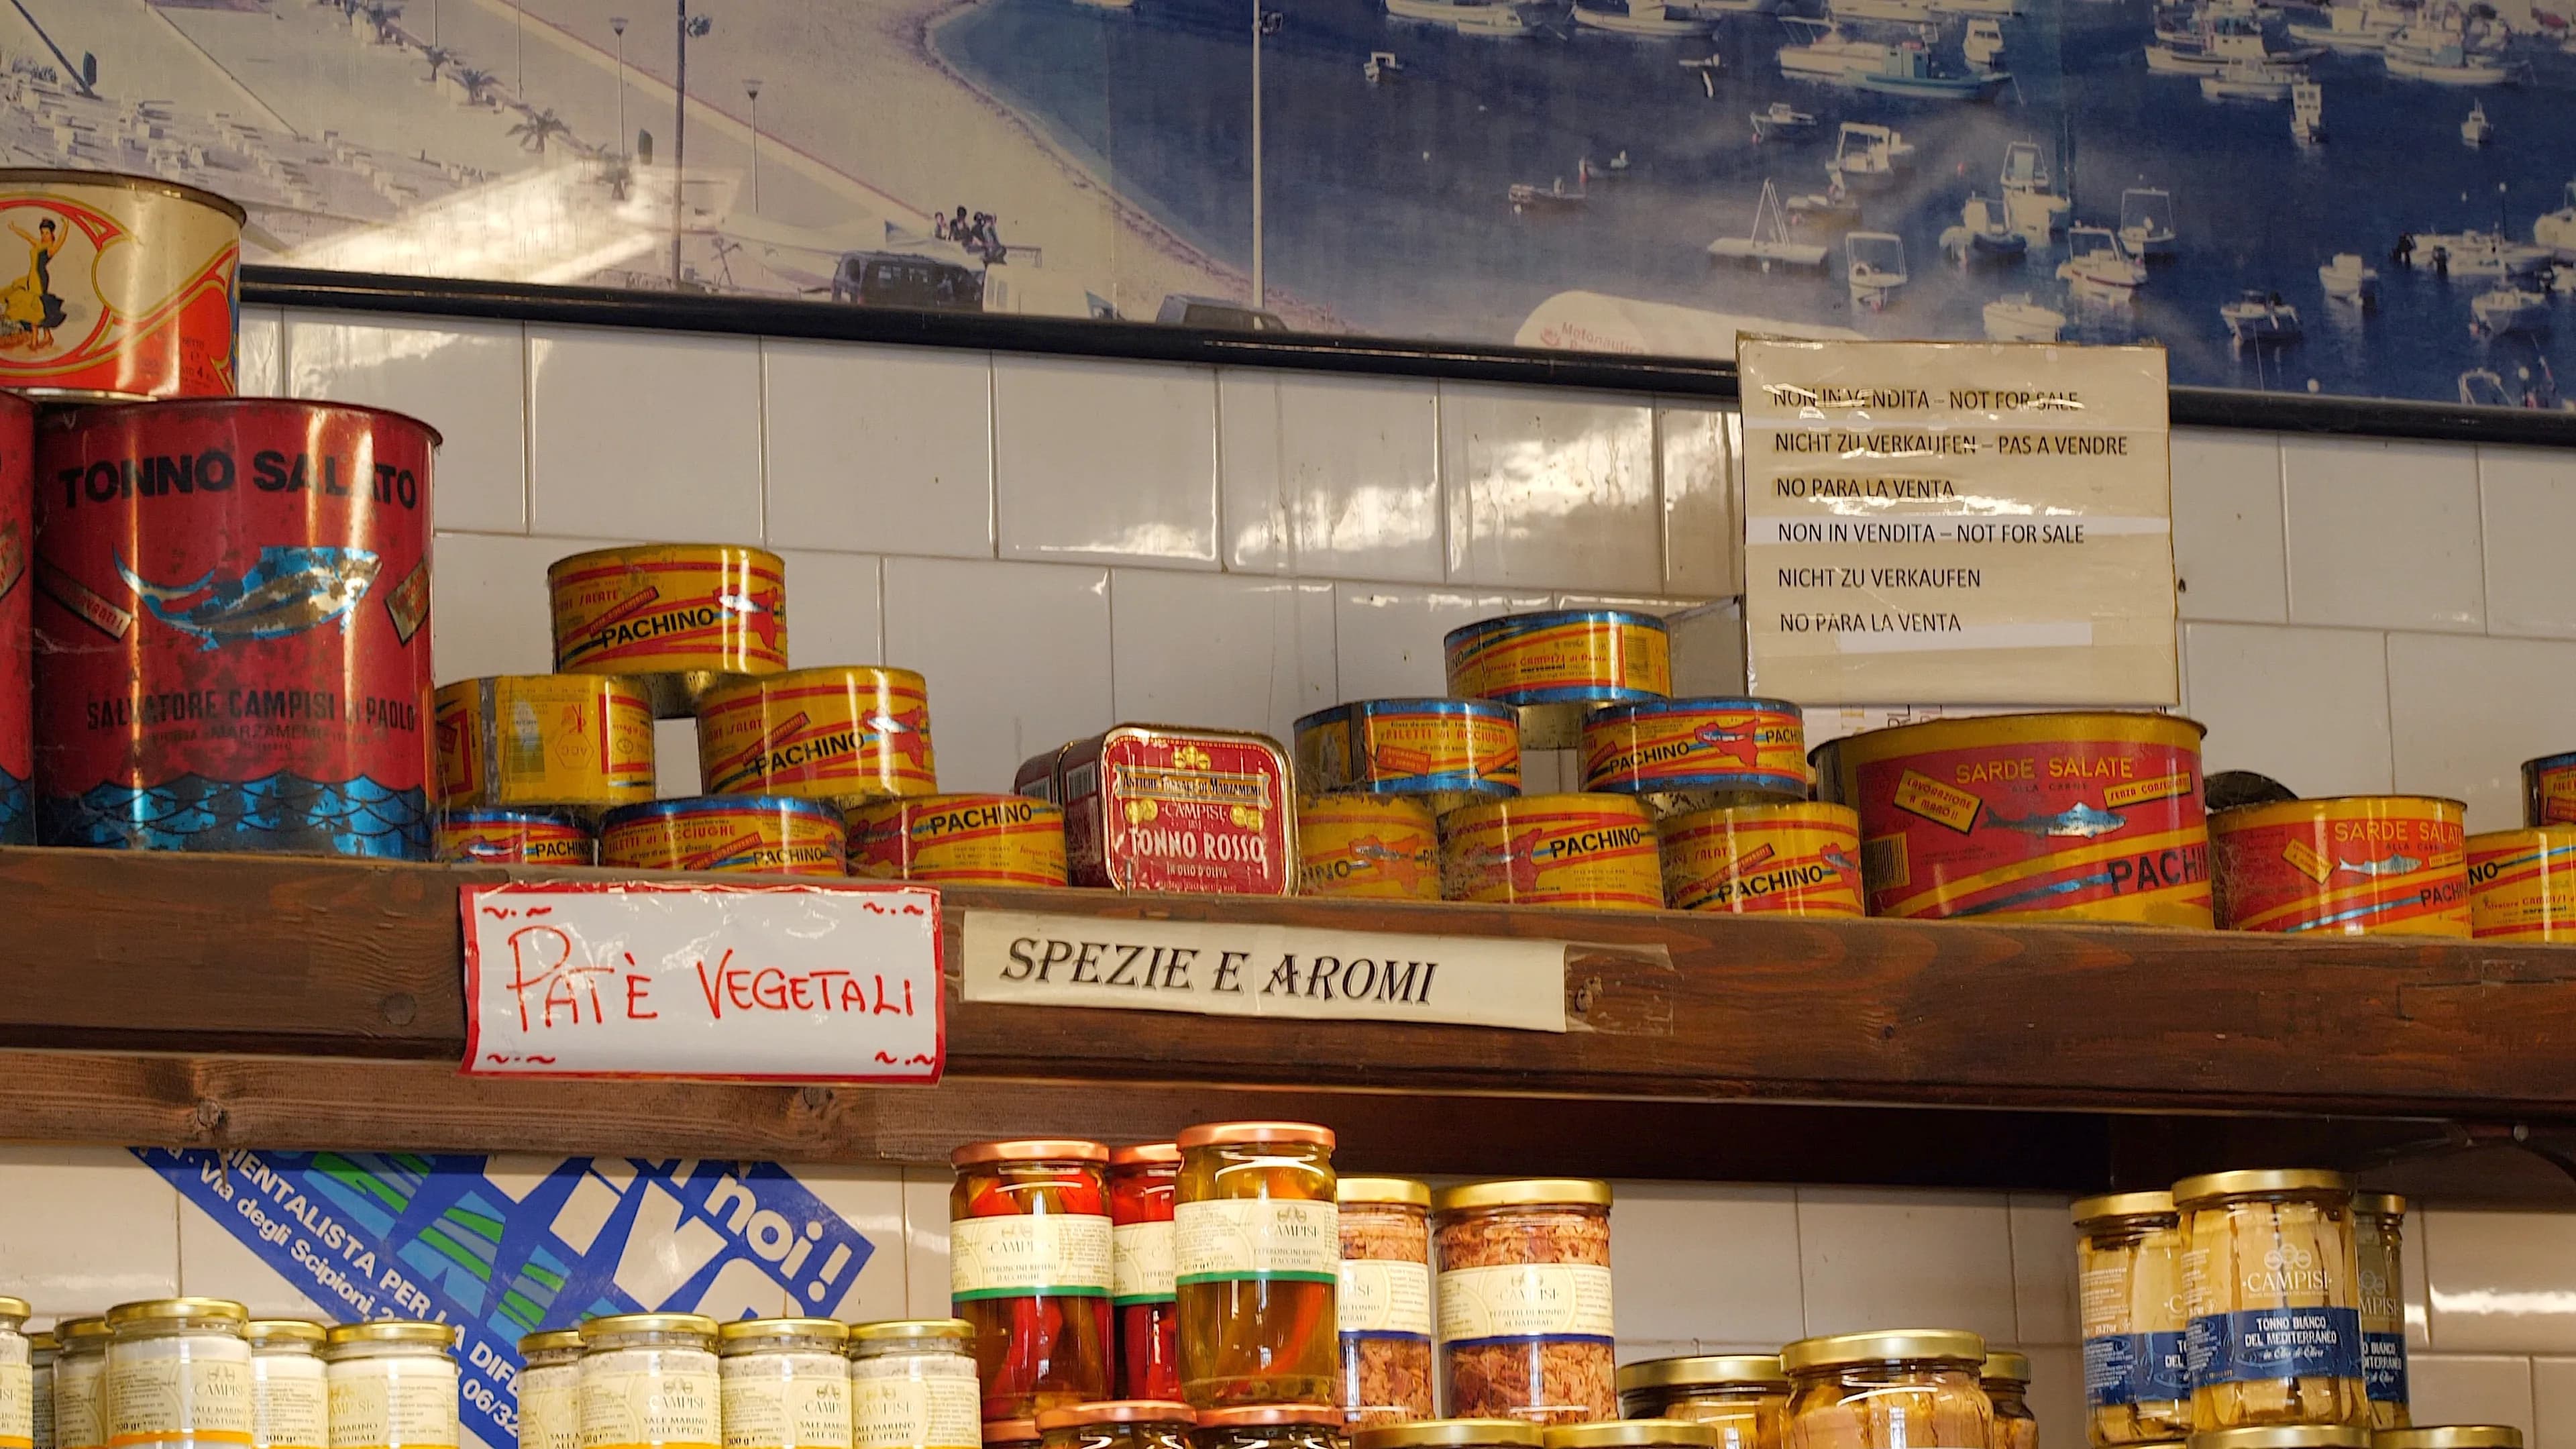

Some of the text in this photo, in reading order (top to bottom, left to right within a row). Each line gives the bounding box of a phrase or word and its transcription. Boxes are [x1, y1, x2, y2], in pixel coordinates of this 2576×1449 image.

[1773, 389, 1817, 408] NON
[1822, 390, 1841, 408] IN
[1847, 390, 1929, 409] VENDITA
[1950, 390, 1989, 409] NOT
[1996, 391, 2029, 410] FOR
[2037, 392, 2078, 411] SALE
[1776, 433, 1831, 452] NICHT
[1838, 434, 1862, 453] ZU
[1868, 434, 1976, 455] VERKAUFEN
[1998, 436, 2033, 454] PAS
[2037, 436, 2049, 454] A
[2055, 436, 2128, 455] VENDRE
[59, 449, 235, 509] TONNO
[1777, 478, 1954, 498] NO PARA LA VENTA
[1778, 523, 1821, 542] NON
[1829, 524, 1847, 542] IN
[1854, 524, 1935, 543] VENDITA
[1957, 525, 1996, 543] NOT
[2002, 525, 2037, 543] FOR
[2043, 525, 2084, 544] SALE
[1778, 569, 1981, 588] NICHT ZU VERKAUFEN
[602, 608, 714, 647] PACHINO
[1780, 614, 1962, 633] NO PARA LA VENTA
[87, 691, 217, 730] SALVATORE
[229, 689, 335, 722] CAMPISI
[366, 697, 415, 732] PAOLO
[1765, 729, 1803, 744] PACH
[755, 732, 865, 776] PACHINO
[1610, 741, 1689, 774] PACHINO
[1955, 755, 2134, 784] SARDE SALATE
[1907, 777, 1972, 810] LAVORAZIONE
[930, 802, 1032, 835] PACHINO
[2334, 820, 2408, 843] SARDE
[753, 847, 823, 866] PACHINO
[1130, 826, 1265, 863] TONNO ROSSO
[1550, 826, 1641, 859] PACHINO
[1719, 865, 1823, 903] PACHINO
[506, 924, 916, 1032] PATÈ VEGETALI
[1000, 936, 1438, 1009] SPEZIE E AROMI
[201, 1159, 234, 1201] Via
[237, 1197, 292, 1246] degli
[290, 1238, 375, 1322] Scipioni,
[703, 1170, 852, 1303] noi!
[379, 1267, 431, 1320] PER
[1499, 1287, 1556, 1301] CAMISI
[2247, 1271, 2328, 1292] CAMPISI
[2359, 1297, 2397, 1316] MPISI
[2256, 1316, 2326, 1331] TONNO BIANCO
[2245, 1330, 2337, 1348] DEL MEDITERRANEO
[2165, 1354, 2183, 1368] DEL
